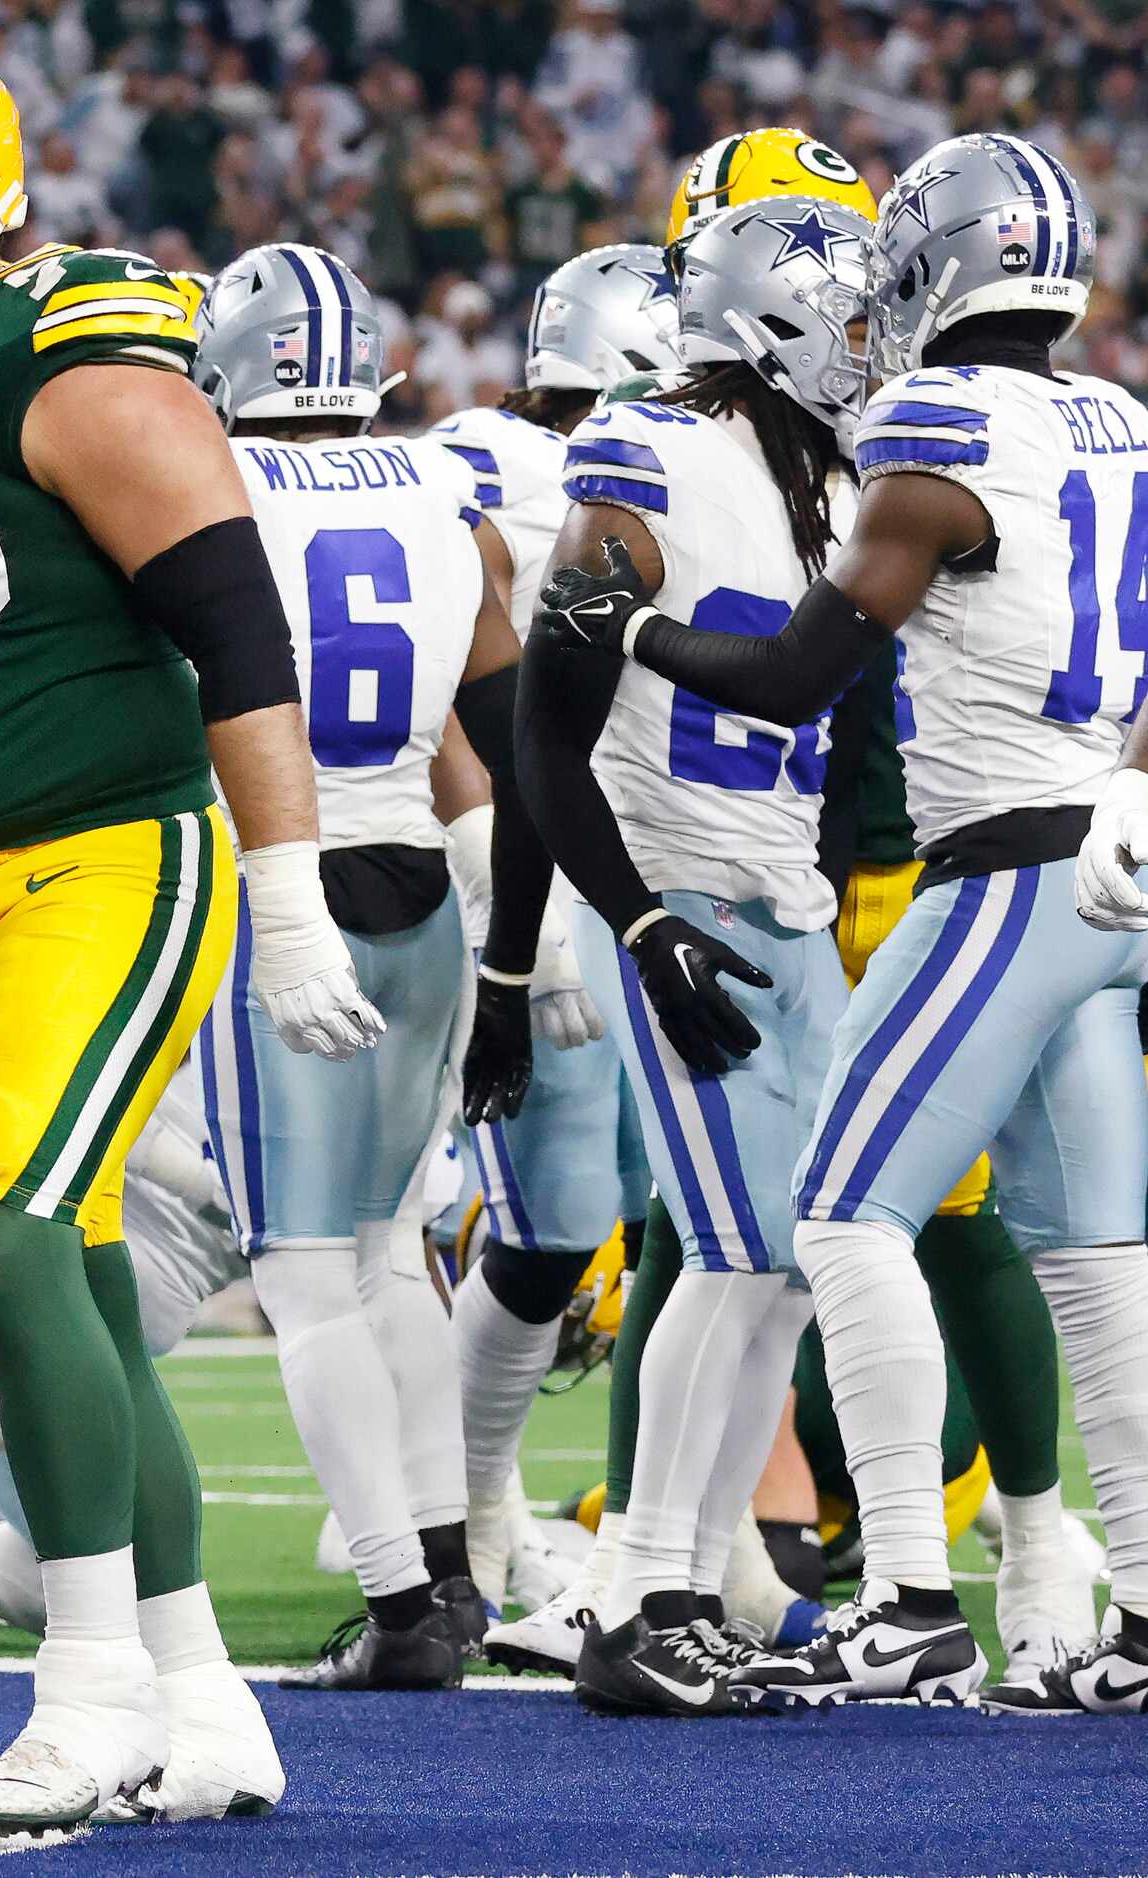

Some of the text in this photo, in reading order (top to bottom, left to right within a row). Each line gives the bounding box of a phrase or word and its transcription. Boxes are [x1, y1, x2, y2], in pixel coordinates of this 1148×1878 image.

[1002, 253, 1029, 266] MLK
[1031, 284, 1070, 296] BE LOVE
[275, 367, 301, 380] MLK
[294, 395, 356, 407] BE LOVE
[1051, 397, 1148, 454] BELL
[244, 445, 422, 492] WILSON
[304, 527, 415, 768] 6
